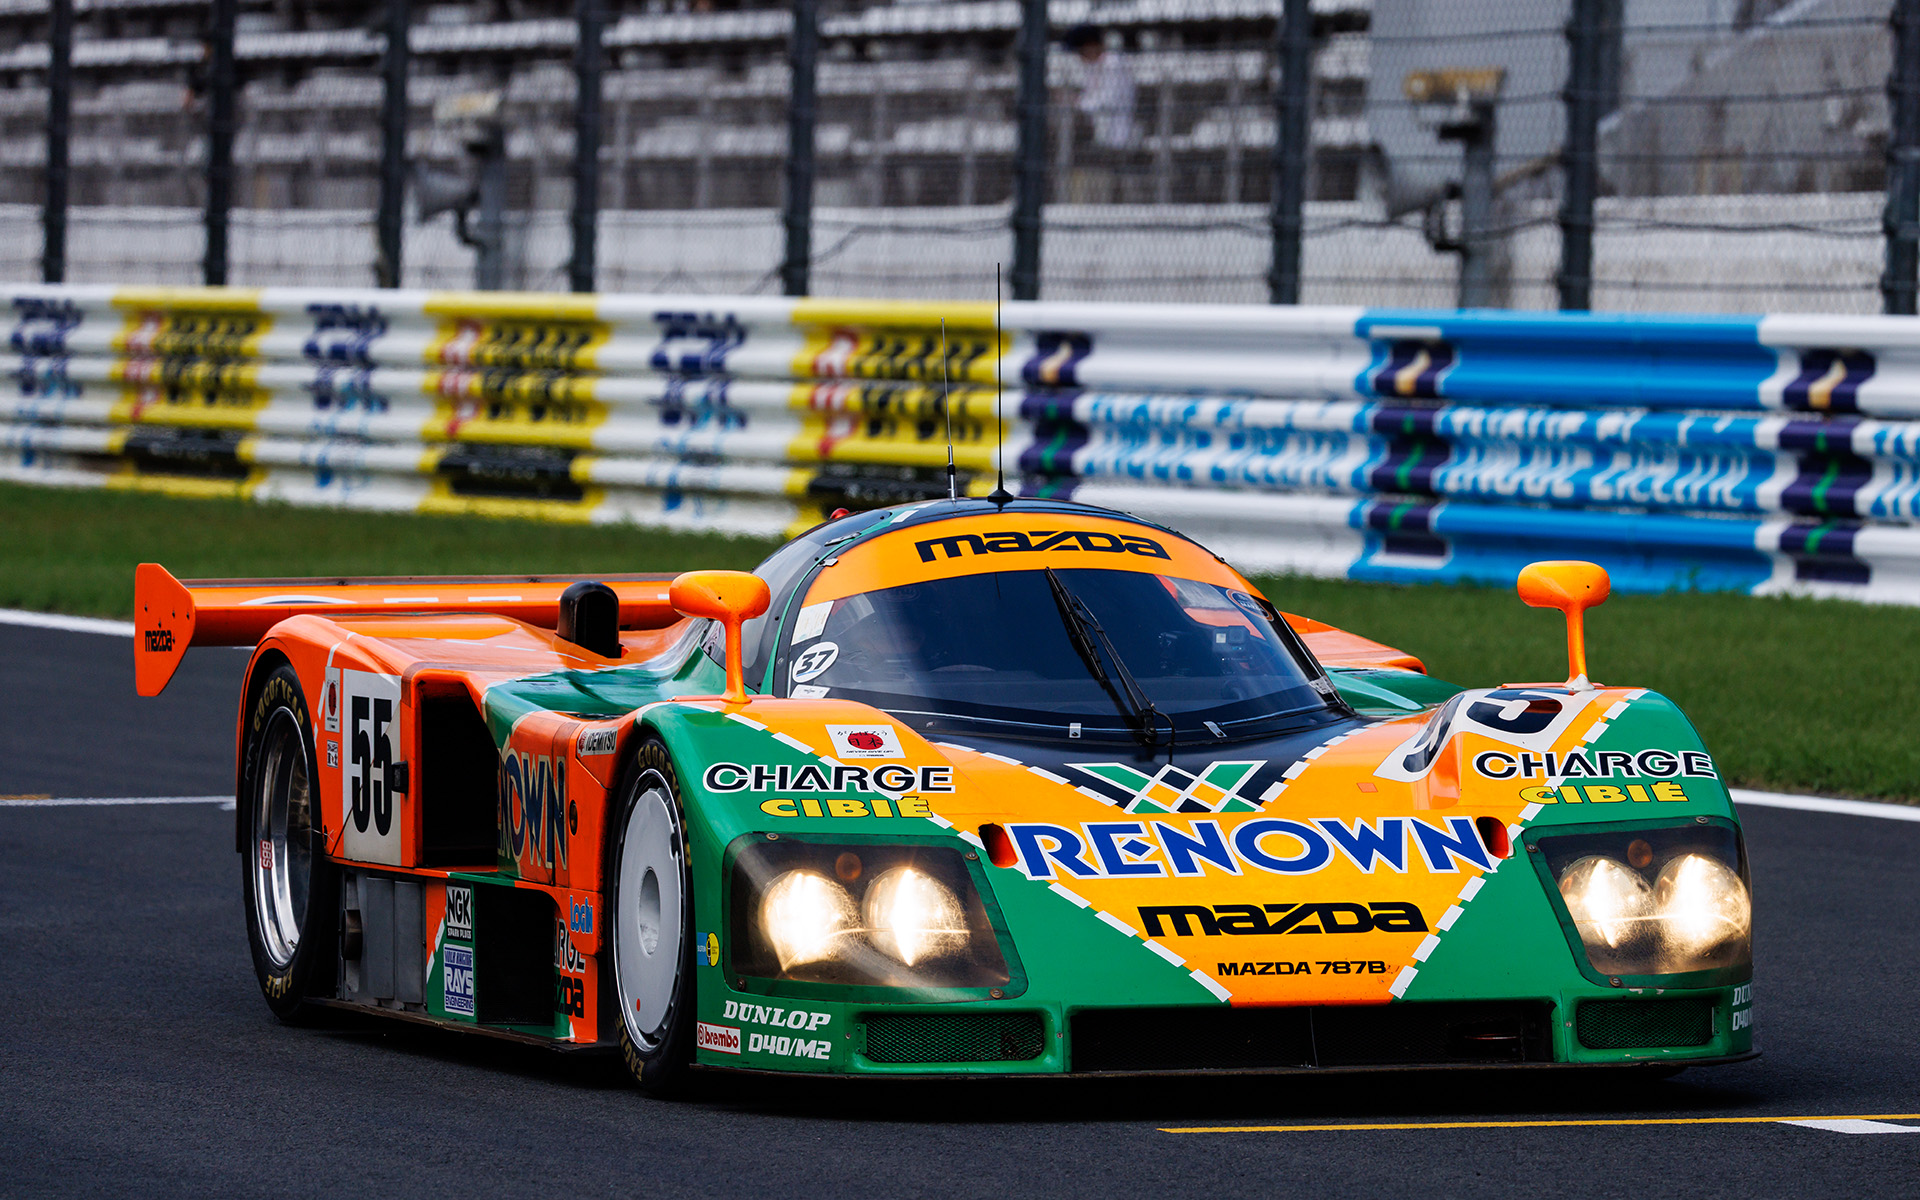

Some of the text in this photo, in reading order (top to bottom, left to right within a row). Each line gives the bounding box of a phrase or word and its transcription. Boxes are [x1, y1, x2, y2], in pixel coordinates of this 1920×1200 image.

[796, 649, 835, 675] 37
[352, 695, 392, 836] 55
[702, 762, 955, 793] CHARGE
[1472, 750, 1718, 780] CHARGE
[1519, 781, 1690, 804] CIBIÉ
[759, 796, 934, 818] CIBIÉ
[261, 840, 272, 868] BBS
[1003, 816, 1497, 881] RENOWN
[447, 888, 471, 926] NGK
[444, 967, 473, 995] RAYS
[1217, 960, 1387, 976] MAZDA 787B
[445, 995, 474, 1009] ENGINEERING
[723, 1000, 831, 1031] DUNLOP
[704, 1026, 739, 1049] brembo
[748, 1033, 832, 1060] D40/M2
